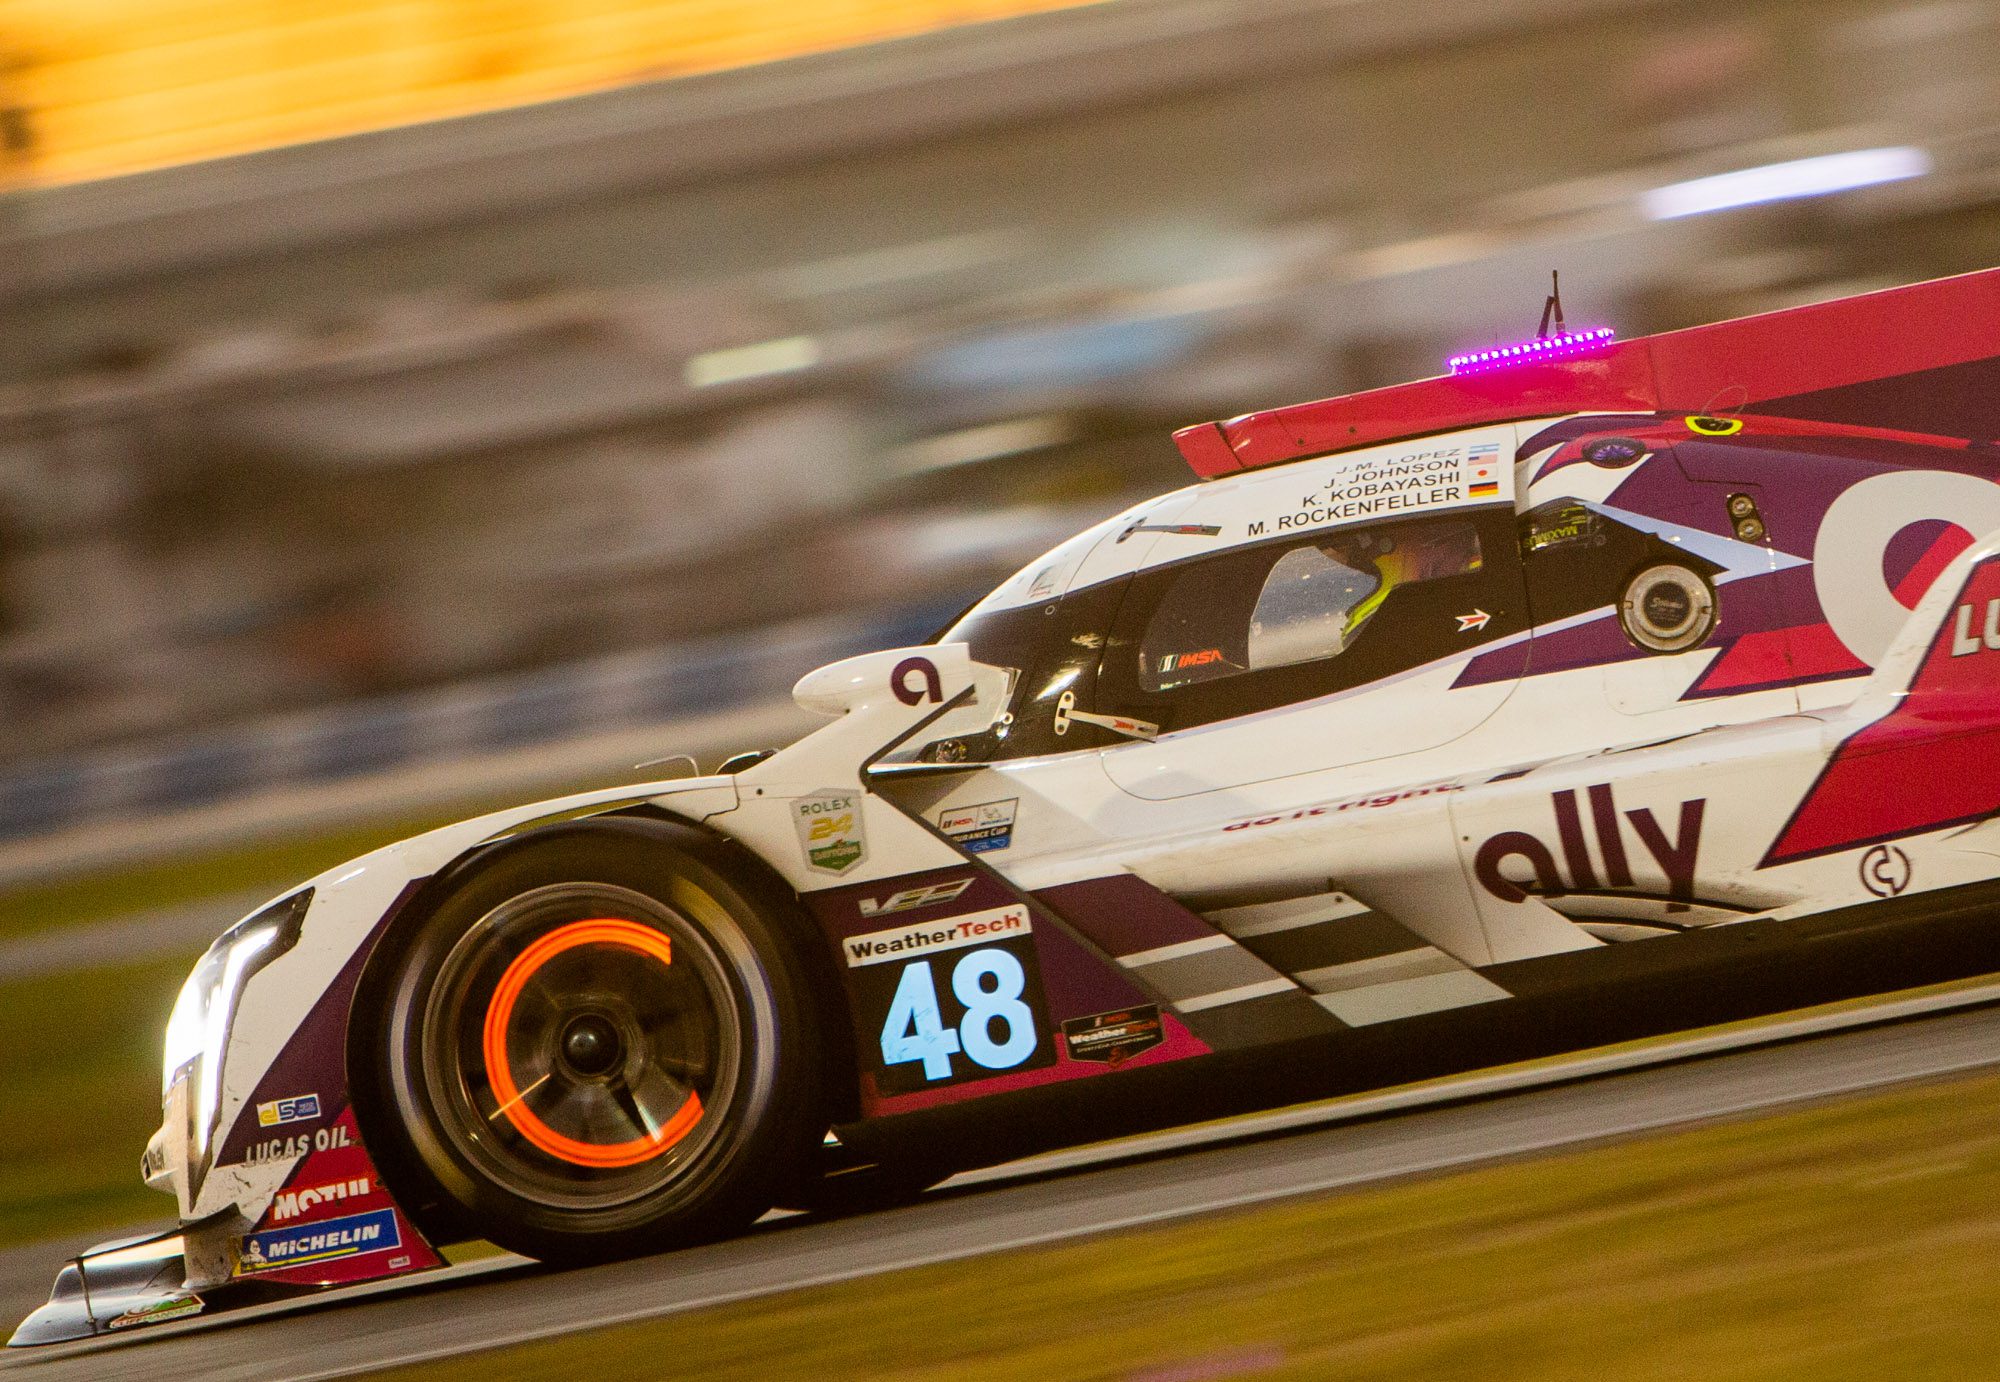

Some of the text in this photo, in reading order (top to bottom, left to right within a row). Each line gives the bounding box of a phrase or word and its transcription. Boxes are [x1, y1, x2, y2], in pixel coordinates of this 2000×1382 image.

[1325, 458, 1459, 489] J. JOHNSON
[1336, 449, 1460, 475] J.M. LOPEZ
[1302, 471, 1460, 508] K. KOBAYASHI
[1248, 487, 1461, 537] M. ROCKENFELLER
[1178, 648, 1223, 669] IMSA
[800, 797, 852, 816] ROLEX
[808, 812, 854, 841] 24
[1474, 783, 1706, 913] ally
[850, 914, 1020, 959] WeatherTech
[880, 948, 1038, 1081] 48
[245, 1125, 351, 1168] LUCAS OIL
[268, 1224, 380, 1258] MICHELIN
